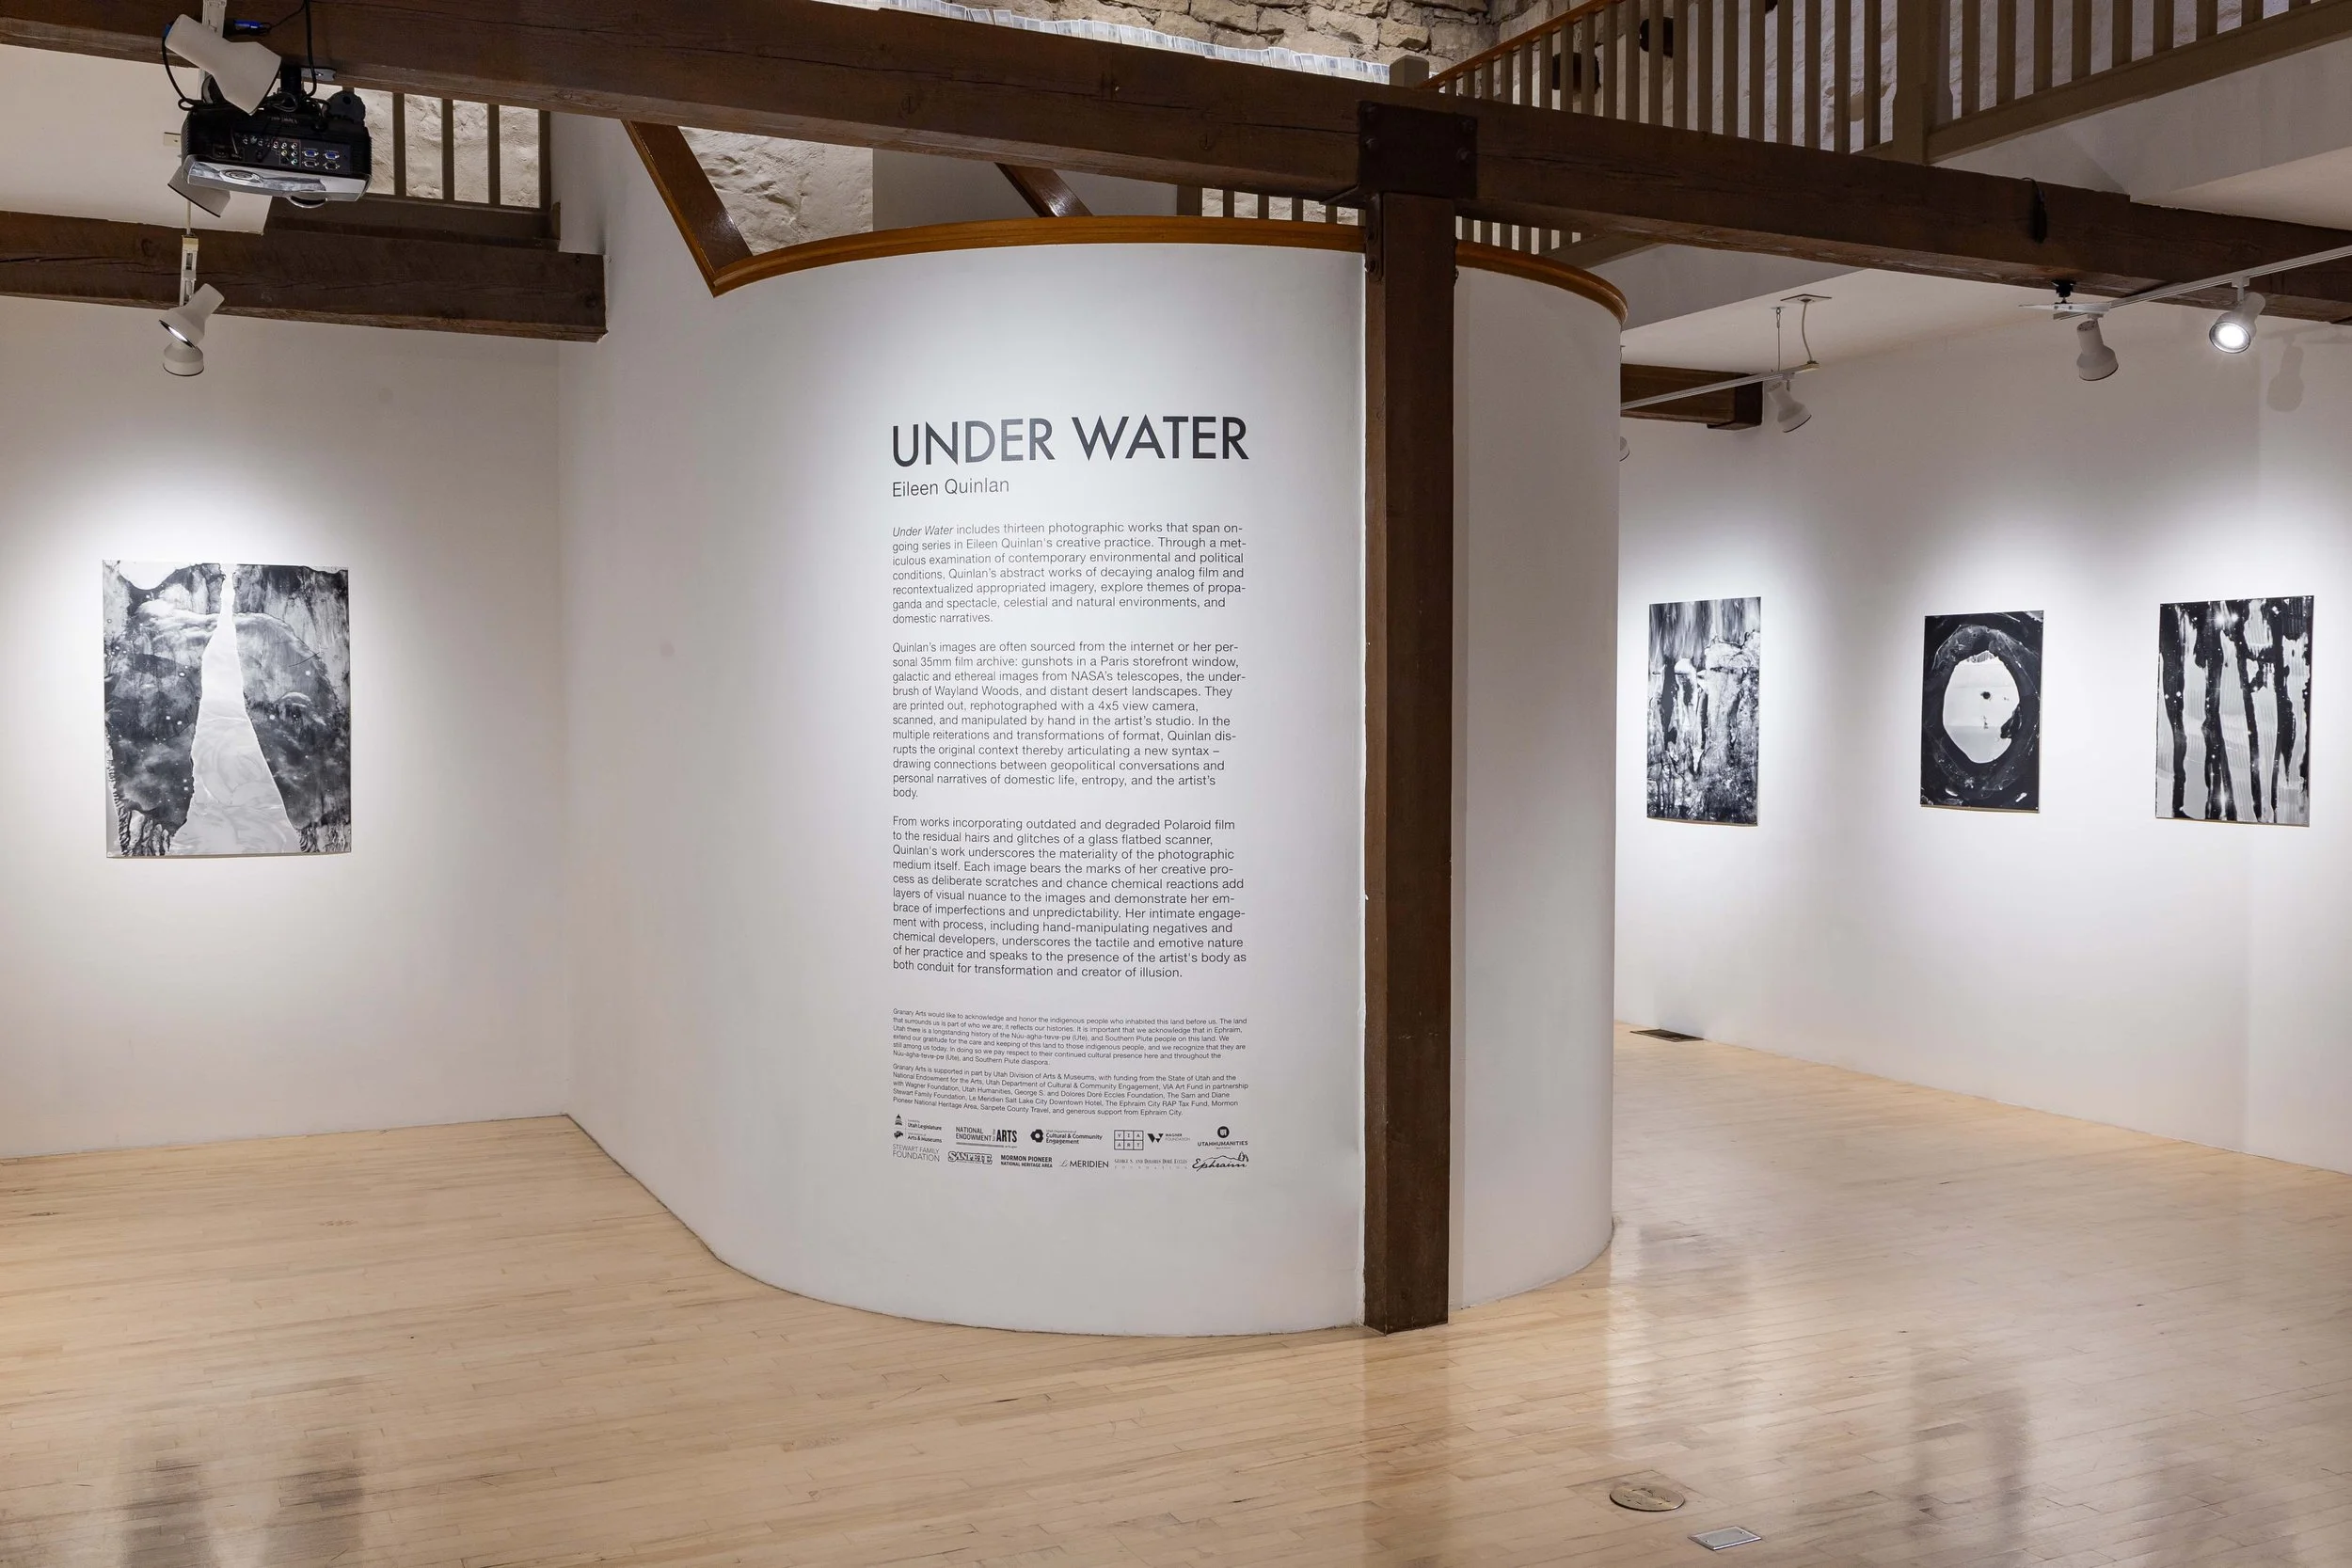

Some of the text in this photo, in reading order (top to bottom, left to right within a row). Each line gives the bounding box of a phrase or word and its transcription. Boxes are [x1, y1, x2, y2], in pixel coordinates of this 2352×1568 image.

[893, 414, 1249, 467] UNDER WATER
[893, 478, 1009, 497] Eileen Quinlan
[892, 522, 1243, 537] Under Water includes thirteen photographic works that span on-
[892, 537, 1246, 554] going series in Eileen Quinlan's creative practice. Through a met-
[892, 552, 1244, 566] iculous examination of contemporary environmental and political
[892, 581, 1246, 596] recontextualized appropriated imagery, explore themes of propa-
[892, 656, 1239, 669] sonal 35mm film archive: gunshots in a Paris storefront window,
[892, 685, 1233, 699] brush of Wayland Woods, and distant desert landscapes. They
[892, 729, 1236, 743] multiple reiterations and transformations of format, Quinlan dis-
[893, 816, 1235, 832] From works incorporating outdated and degraded Polaroid film
[892, 875, 1244, 889] cess as deliberate scratches and chance chemical reactions add
[893, 917, 1232, 936] ment with process, including hand-manipulating negatives and
[893, 1007, 914, 1018] Granary
[927, 1010, 945, 1018] would
[964, 1013, 1004, 1023] acknowledge
[1049, 1017, 1085, 1025] indigenous
[1086, 1017, 1109, 1026] people
[893, 1096, 913, 1105] Pioneer
[914, 1098, 937, 1107] National
[938, 1100, 962, 1111] Heritage
[963, 1102, 978, 1111] Area,
[980, 1103, 1005, 1113] Sanpete
[1006, 1105, 1029, 1114] County
[1030, 1106, 1050, 1114] Travel,
[1140, 1108, 1167, 1116] Ephraim
[1168, 1108, 1183, 1116] City.
[996, 1129, 1017, 1142] ARTS
[893, 1150, 939, 1161] FOUNDATION
[919, 1146, 939, 1154] FAMILY
[948, 1151, 993, 1164] SANPETE
[1192, 1158, 1247, 1171] Ephraim
